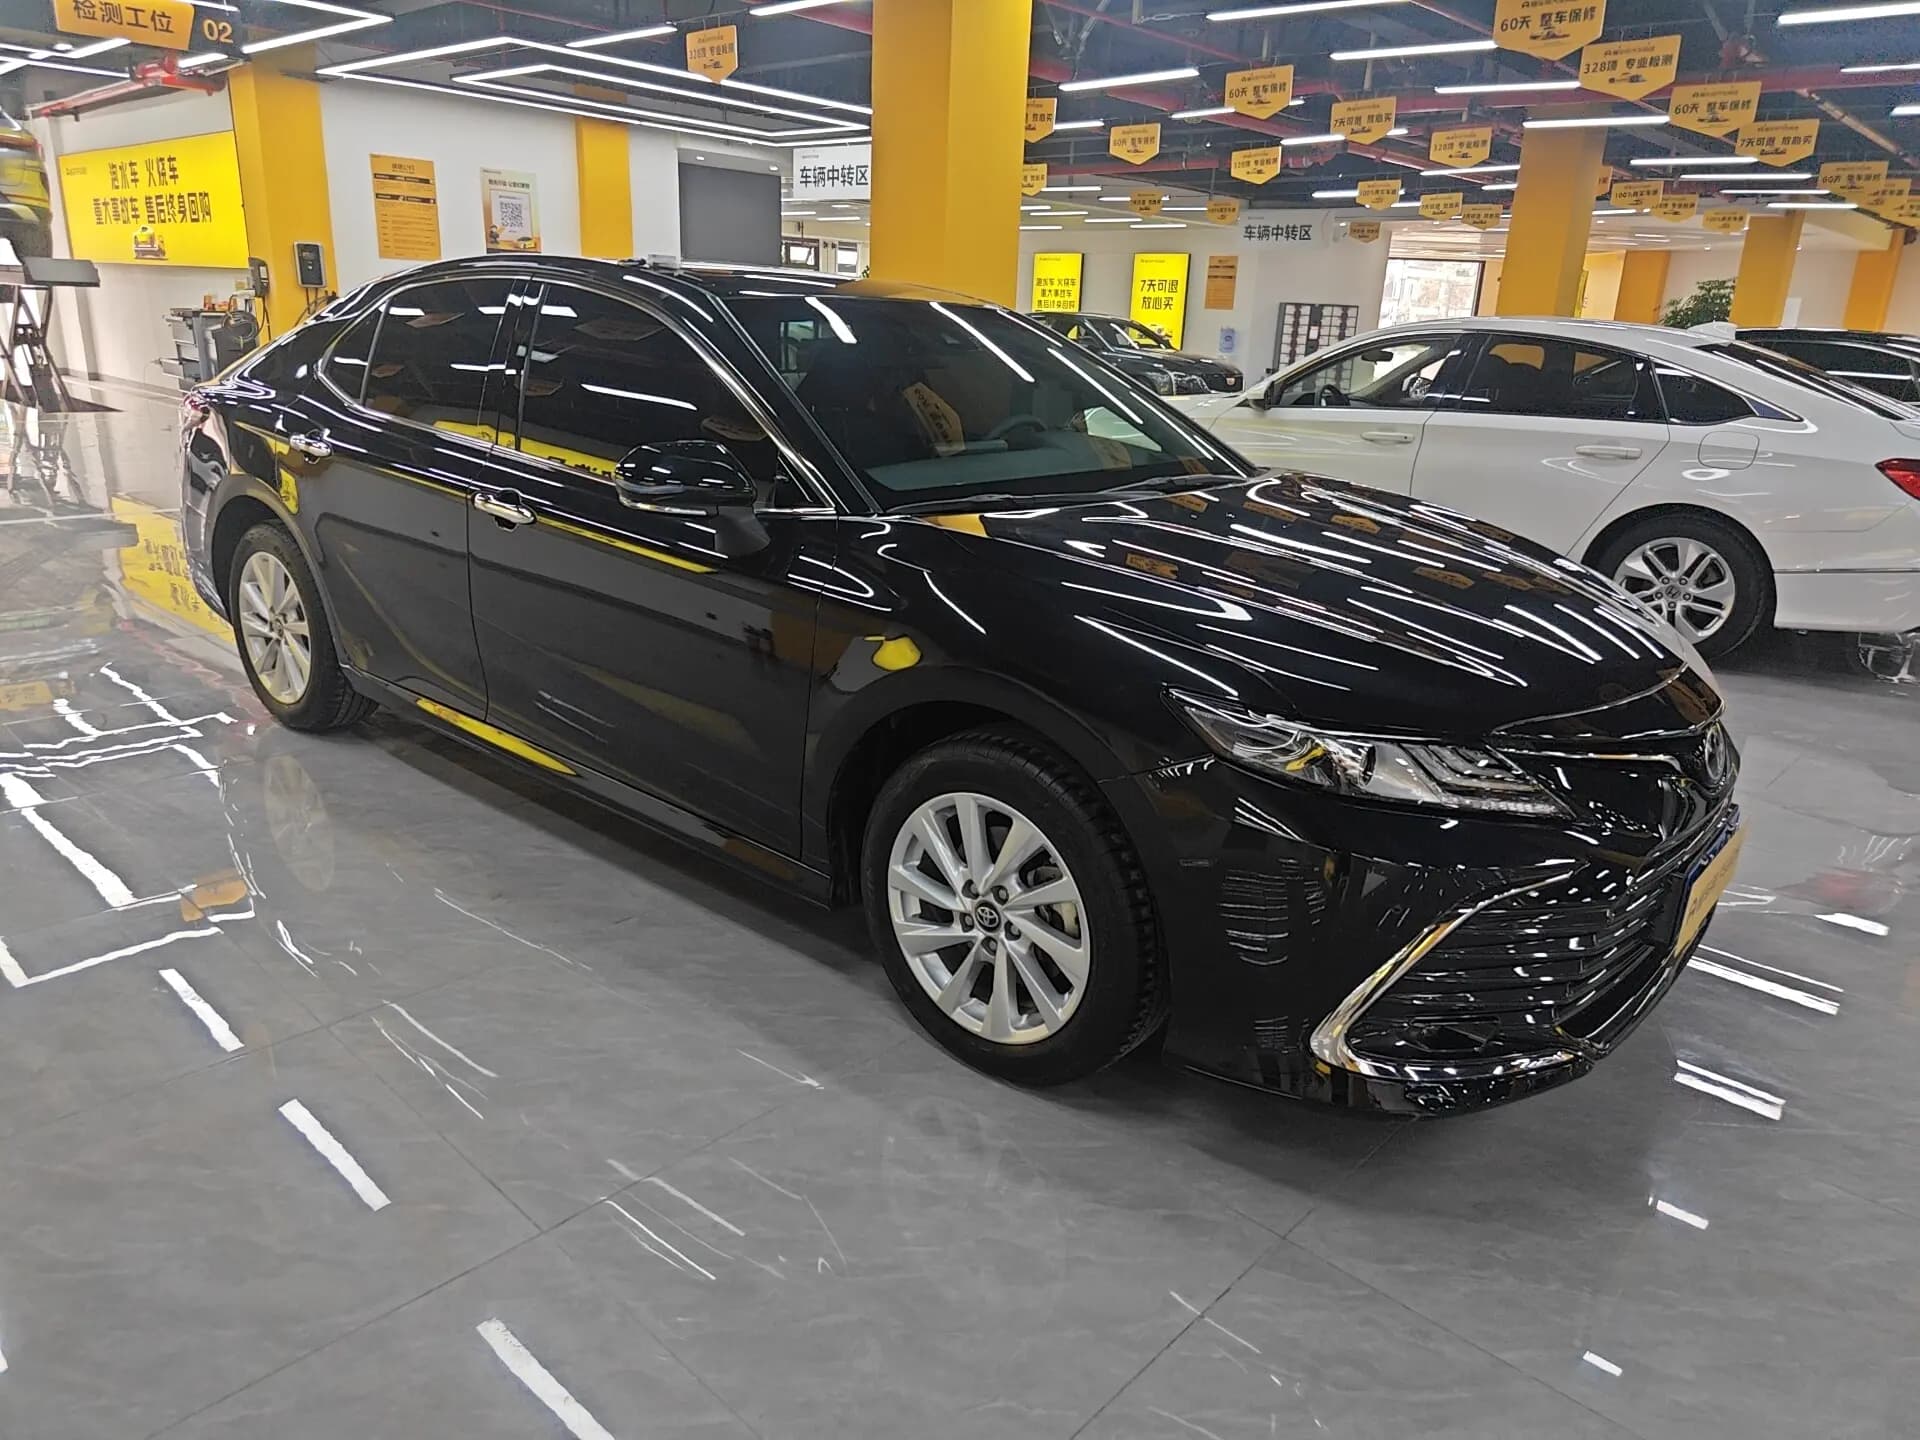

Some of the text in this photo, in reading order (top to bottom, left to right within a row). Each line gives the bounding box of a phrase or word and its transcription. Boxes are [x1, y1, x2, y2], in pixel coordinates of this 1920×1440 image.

[74, 0, 234, 44] 检测工位 02
[1500, 16, 1532, 32] 60天
[108, 155, 179, 190] 泡水车 火烧车
[799, 164, 869, 188] 车辆中转区
[93, 191, 212, 225] 重大事故车 售后终身回购
[1243, 224, 1313, 242] 车辆中转区
[1140, 279, 1179, 293] 7天可退
[1141, 296, 1174, 310] 放心买
